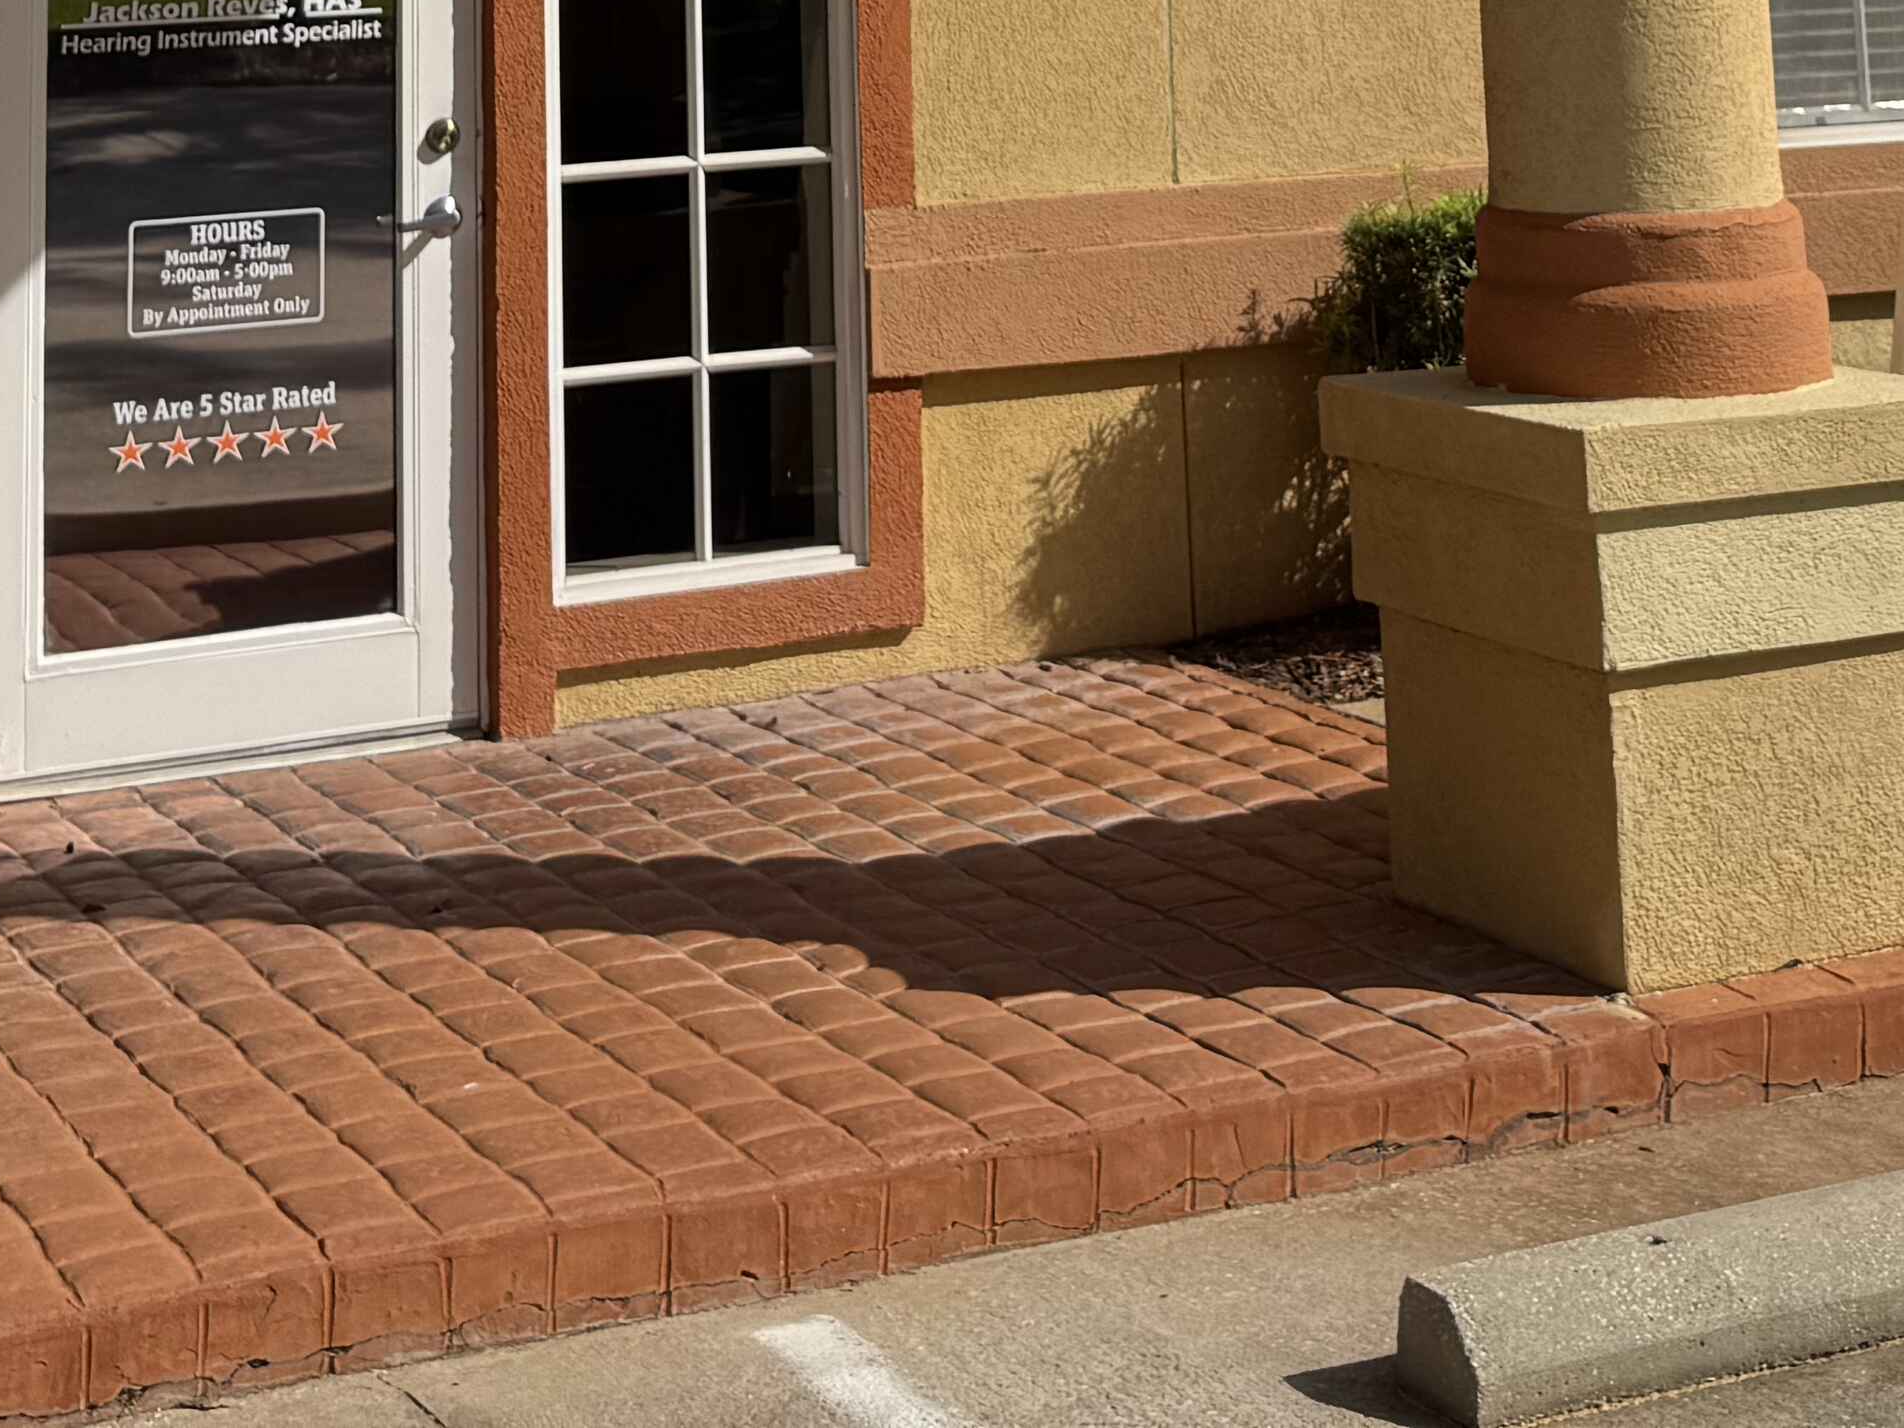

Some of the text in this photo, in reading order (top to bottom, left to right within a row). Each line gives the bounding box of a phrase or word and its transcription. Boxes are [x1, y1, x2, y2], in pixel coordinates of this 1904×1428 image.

[83, 0, 200, 23] Jackson
[61, 19, 383, 56] Hearing Instrument Specialist
[190, 219, 265, 245] HOURS
[164, 246, 227, 266] Monday
[240, 241, 290, 261] Friday
[160, 267, 220, 286] 9:00am
[192, 282, 262, 302] Saturday
[143, 296, 310, 328] By Appointment Only
[113, 381, 337, 425] We Are 5 Star Rated
